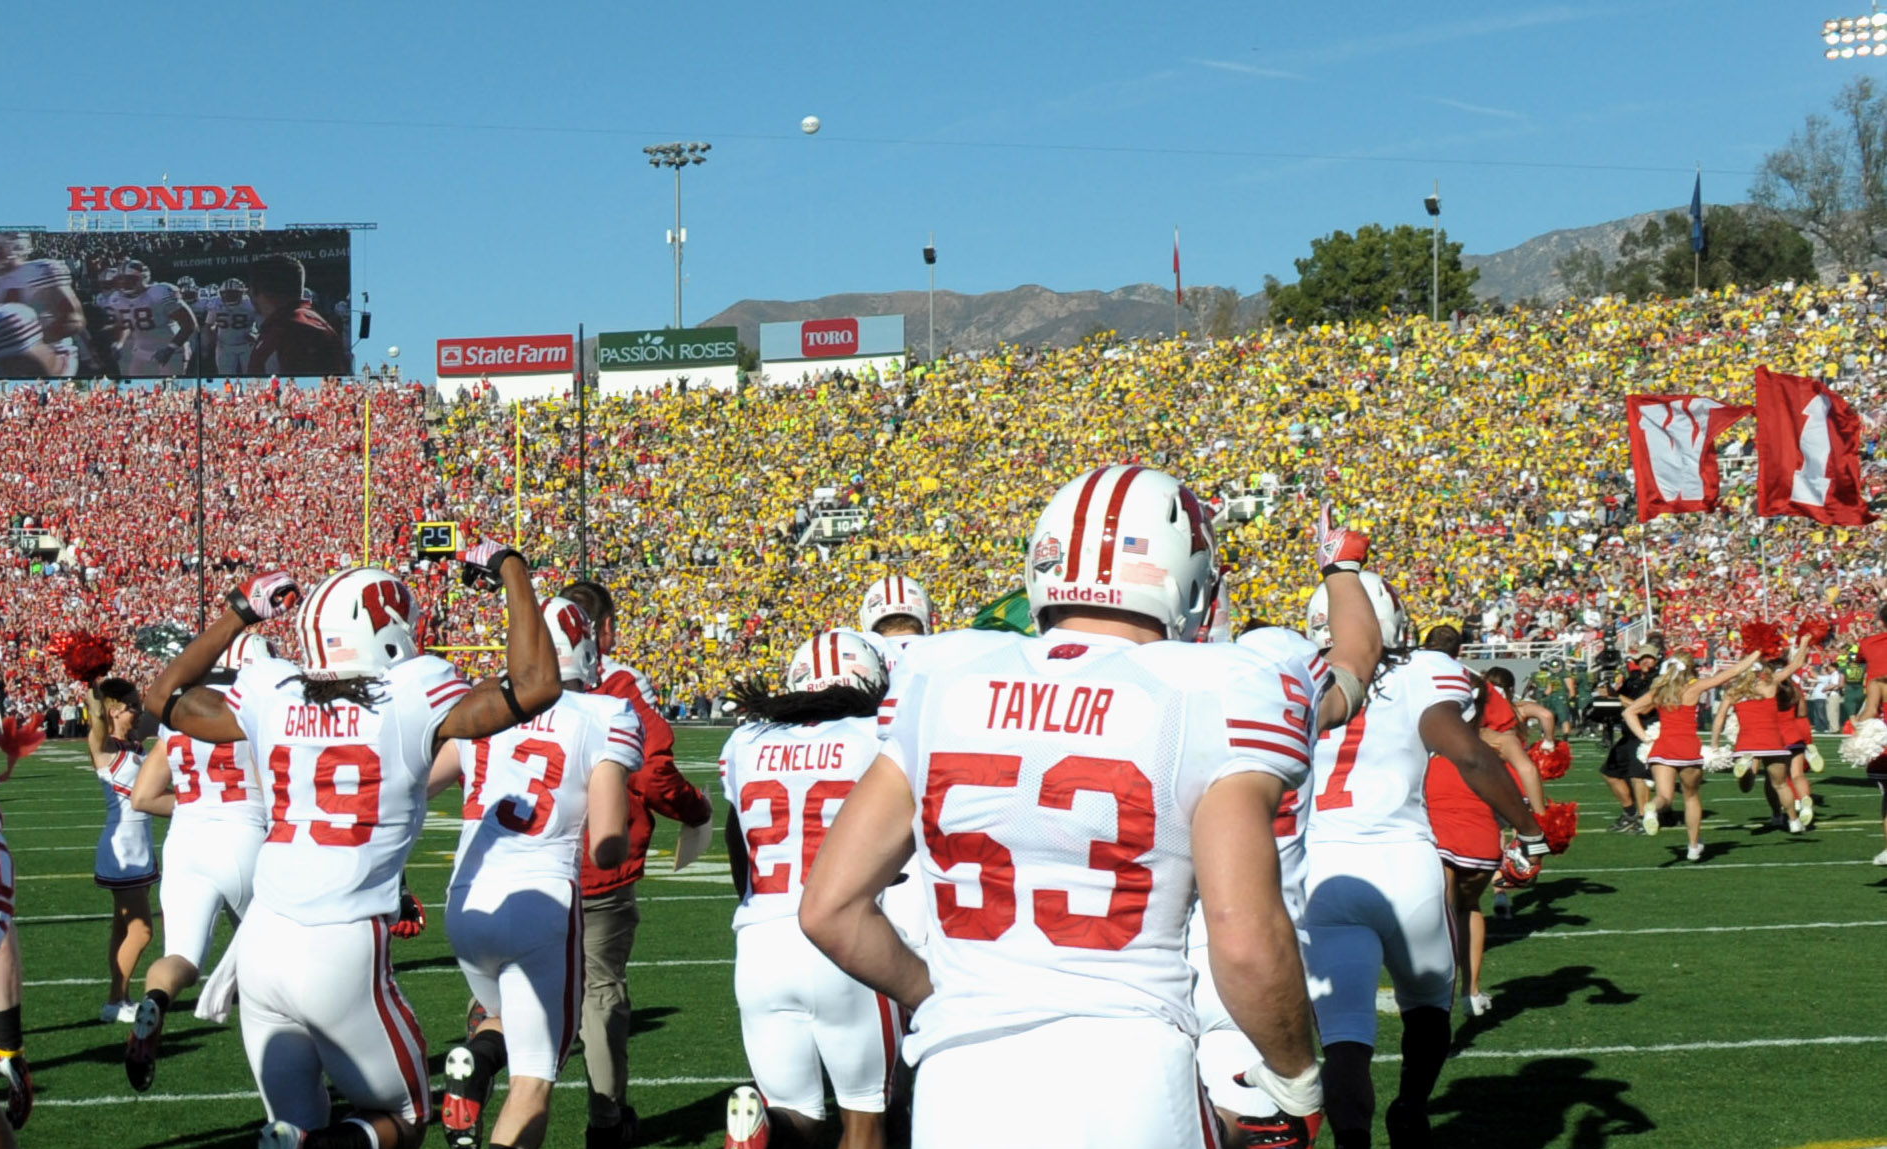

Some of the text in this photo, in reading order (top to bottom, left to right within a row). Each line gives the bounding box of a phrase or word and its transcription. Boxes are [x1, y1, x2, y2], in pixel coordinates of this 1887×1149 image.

[67, 185, 268, 211] HONDA
[599, 340, 736, 364] PASSION ROSES
[804, 330, 853, 347] TORO
[422, 527, 450, 547] 25
[1047, 587, 1123, 605] Riddell
[285, 705, 360, 737] GARNER
[987, 680, 1113, 736] TAYLOR
[166, 734, 247, 805] 34
[757, 743, 844, 772] FENELUS
[264, 744, 381, 848] 19
[462, 735, 566, 837] 13
[922, 752, 1156, 950] 53
